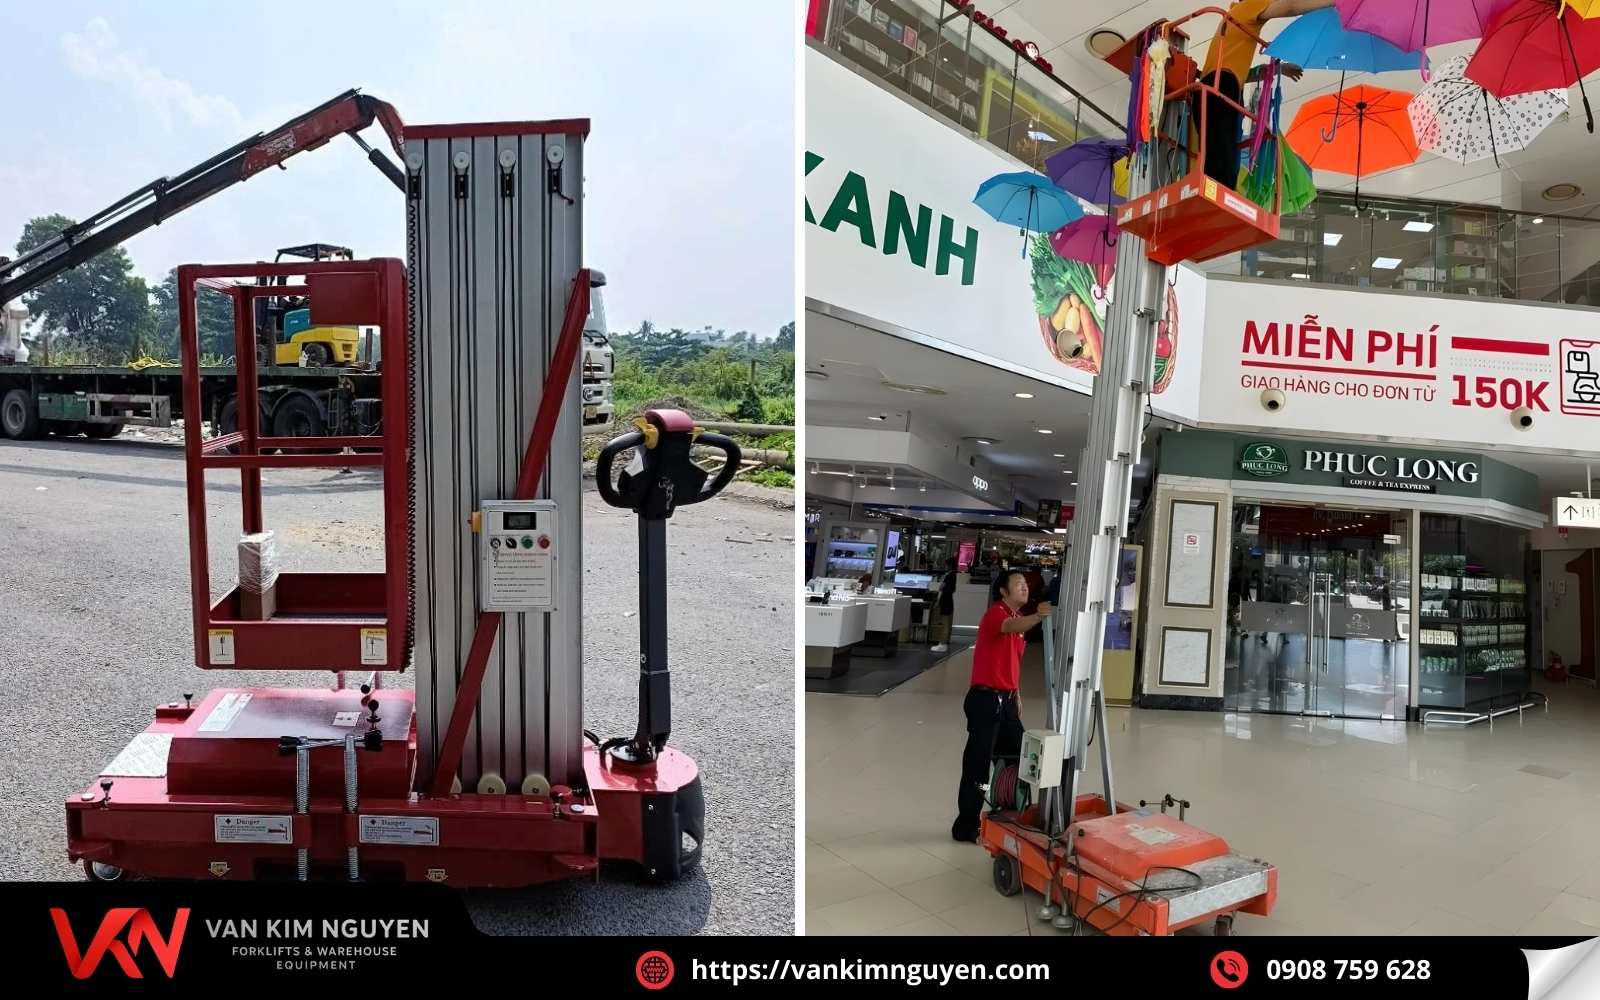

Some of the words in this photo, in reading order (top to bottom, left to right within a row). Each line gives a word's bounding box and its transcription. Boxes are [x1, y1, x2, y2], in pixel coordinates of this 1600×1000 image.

[1242, 313, 1354, 362] MIỄN
[1367, 325, 1440, 369] PHÍ
[1241, 374, 1280, 390] GIAO
[1284, 375, 1330, 395] HÀNG
[1334, 381, 1369, 397] CHO
[1372, 384, 1409, 400] ĐƠN
[1413, 385, 1437, 402] TỪ
[1452, 374, 1550, 412] 150K
[1303, 449, 1388, 477] PHUC
[1396, 457, 1479, 484] LONG
[236, 818, 261, 827] Danger
[381, 819, 406, 828] Danger
